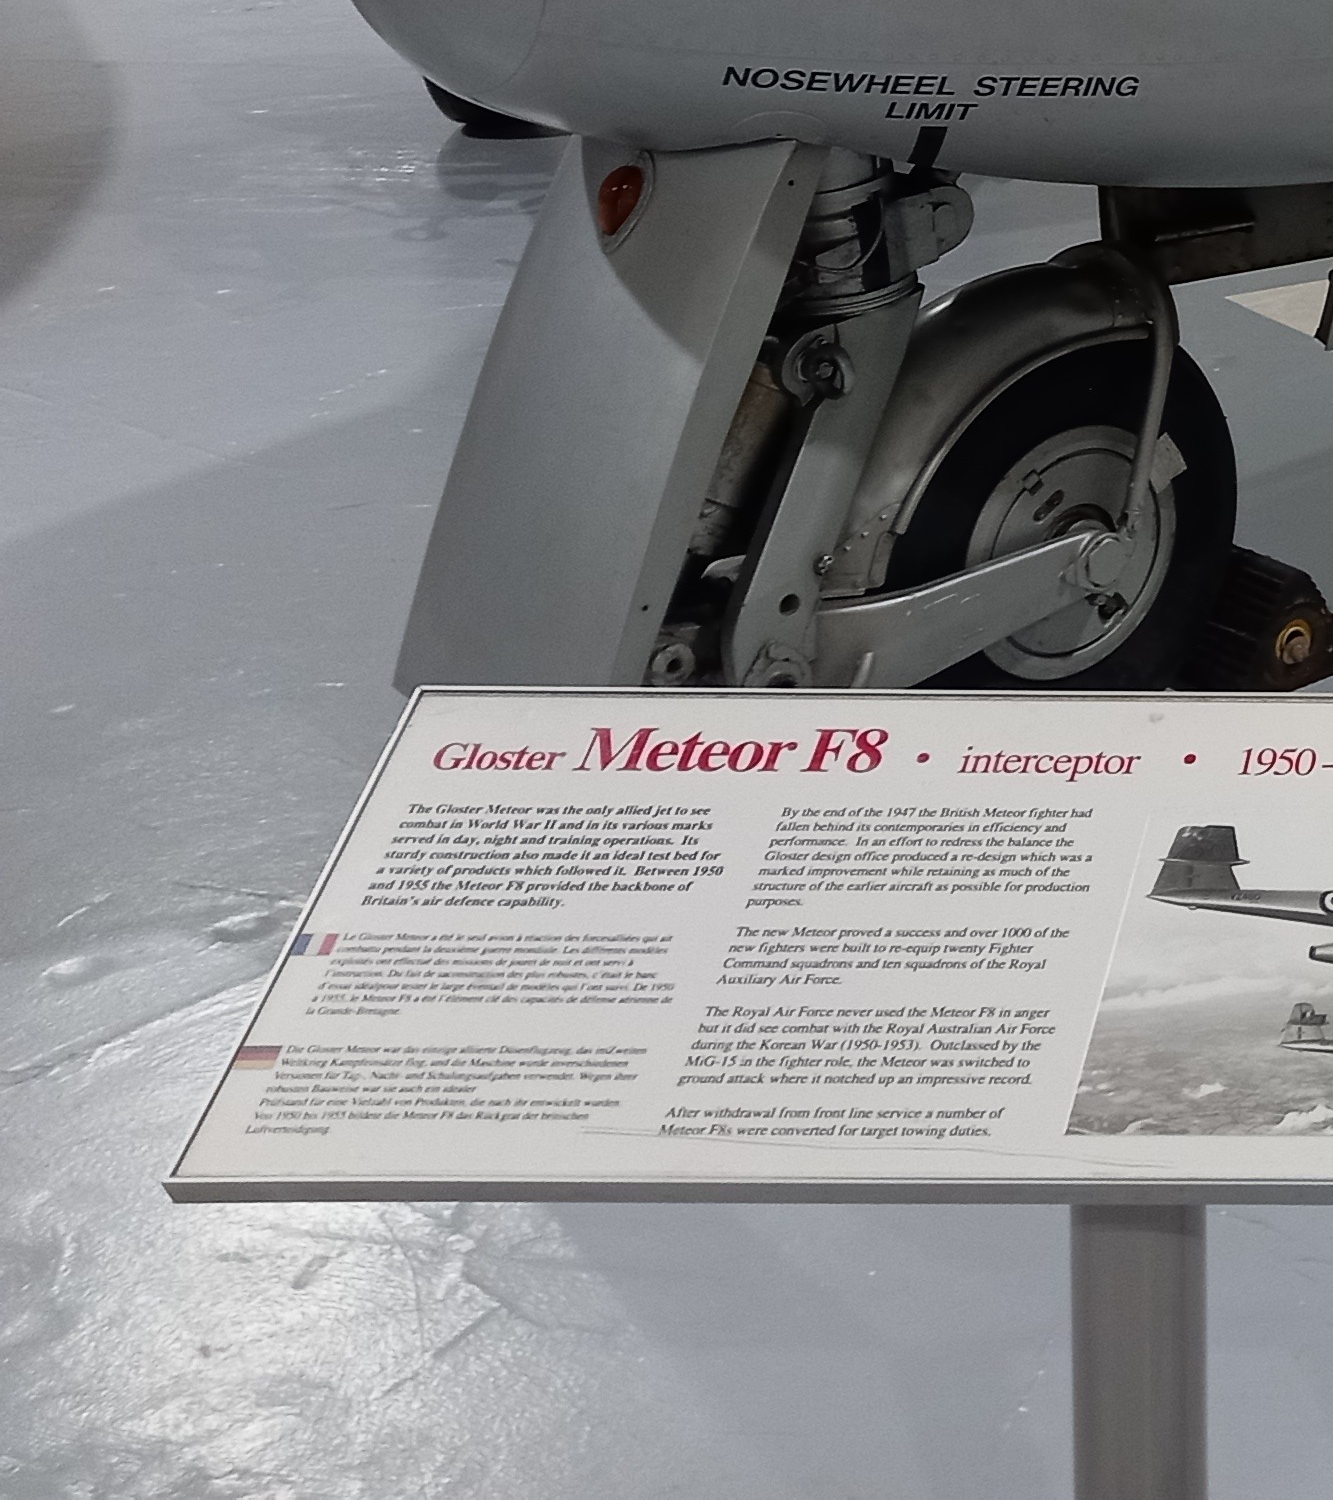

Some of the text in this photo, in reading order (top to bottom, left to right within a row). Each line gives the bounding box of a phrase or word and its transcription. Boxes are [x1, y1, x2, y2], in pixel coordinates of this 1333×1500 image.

[722, 67, 1139, 97] NOSEWHEEL STEERING
[885, 102, 978, 121] LIMIT
[432, 743, 566, 773] Gloster
[573, 727, 799, 772] Meteor
[800, 727, 889, 772] F8
[957, 745, 1141, 782] interceptor
[398, 818, 713, 830] combat in World War II and in its various marks
[360, 895, 565, 909] Britain's air defence capability.
[715, 973, 842, 987] Auxiliary Air Force.
[664, 1106, 1005, 1119] After withdrawal from front line service a number of
